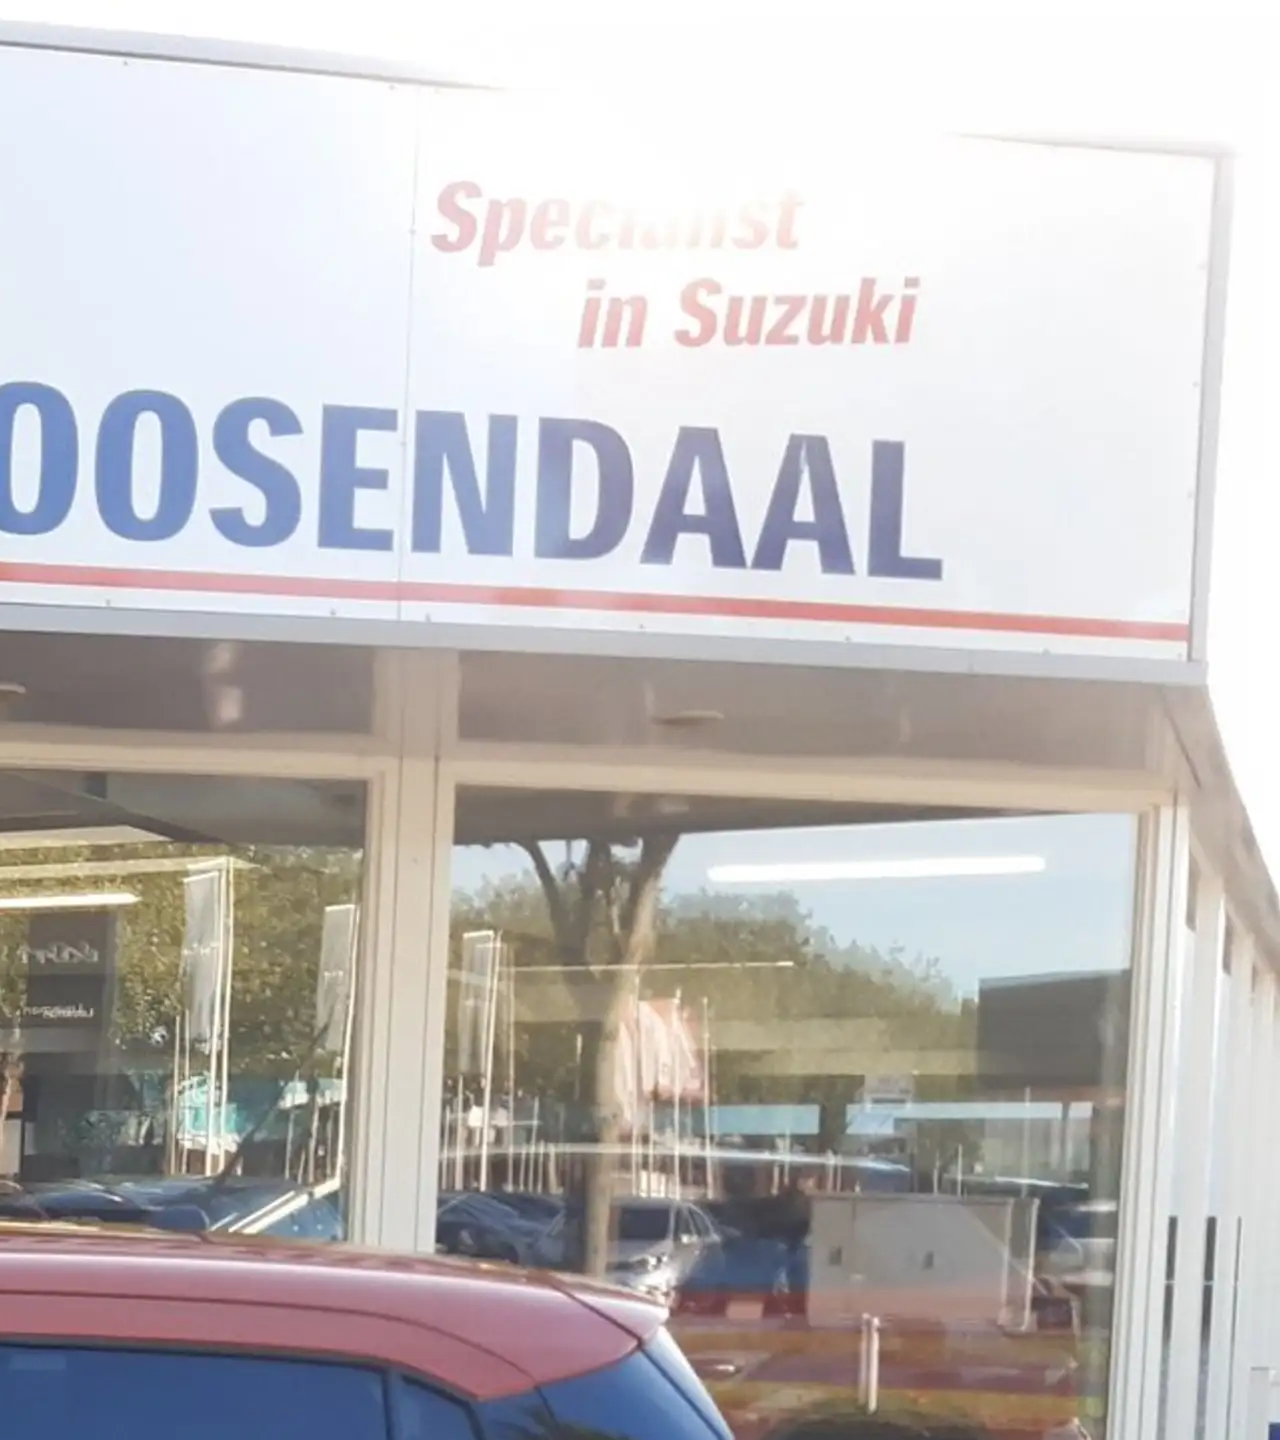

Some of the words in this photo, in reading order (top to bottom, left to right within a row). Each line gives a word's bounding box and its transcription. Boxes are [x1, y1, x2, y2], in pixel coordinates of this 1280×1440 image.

[430, 180, 804, 267] Specialist
[577, 278, 648, 349] in
[673, 276, 921, 349] Suzuki
